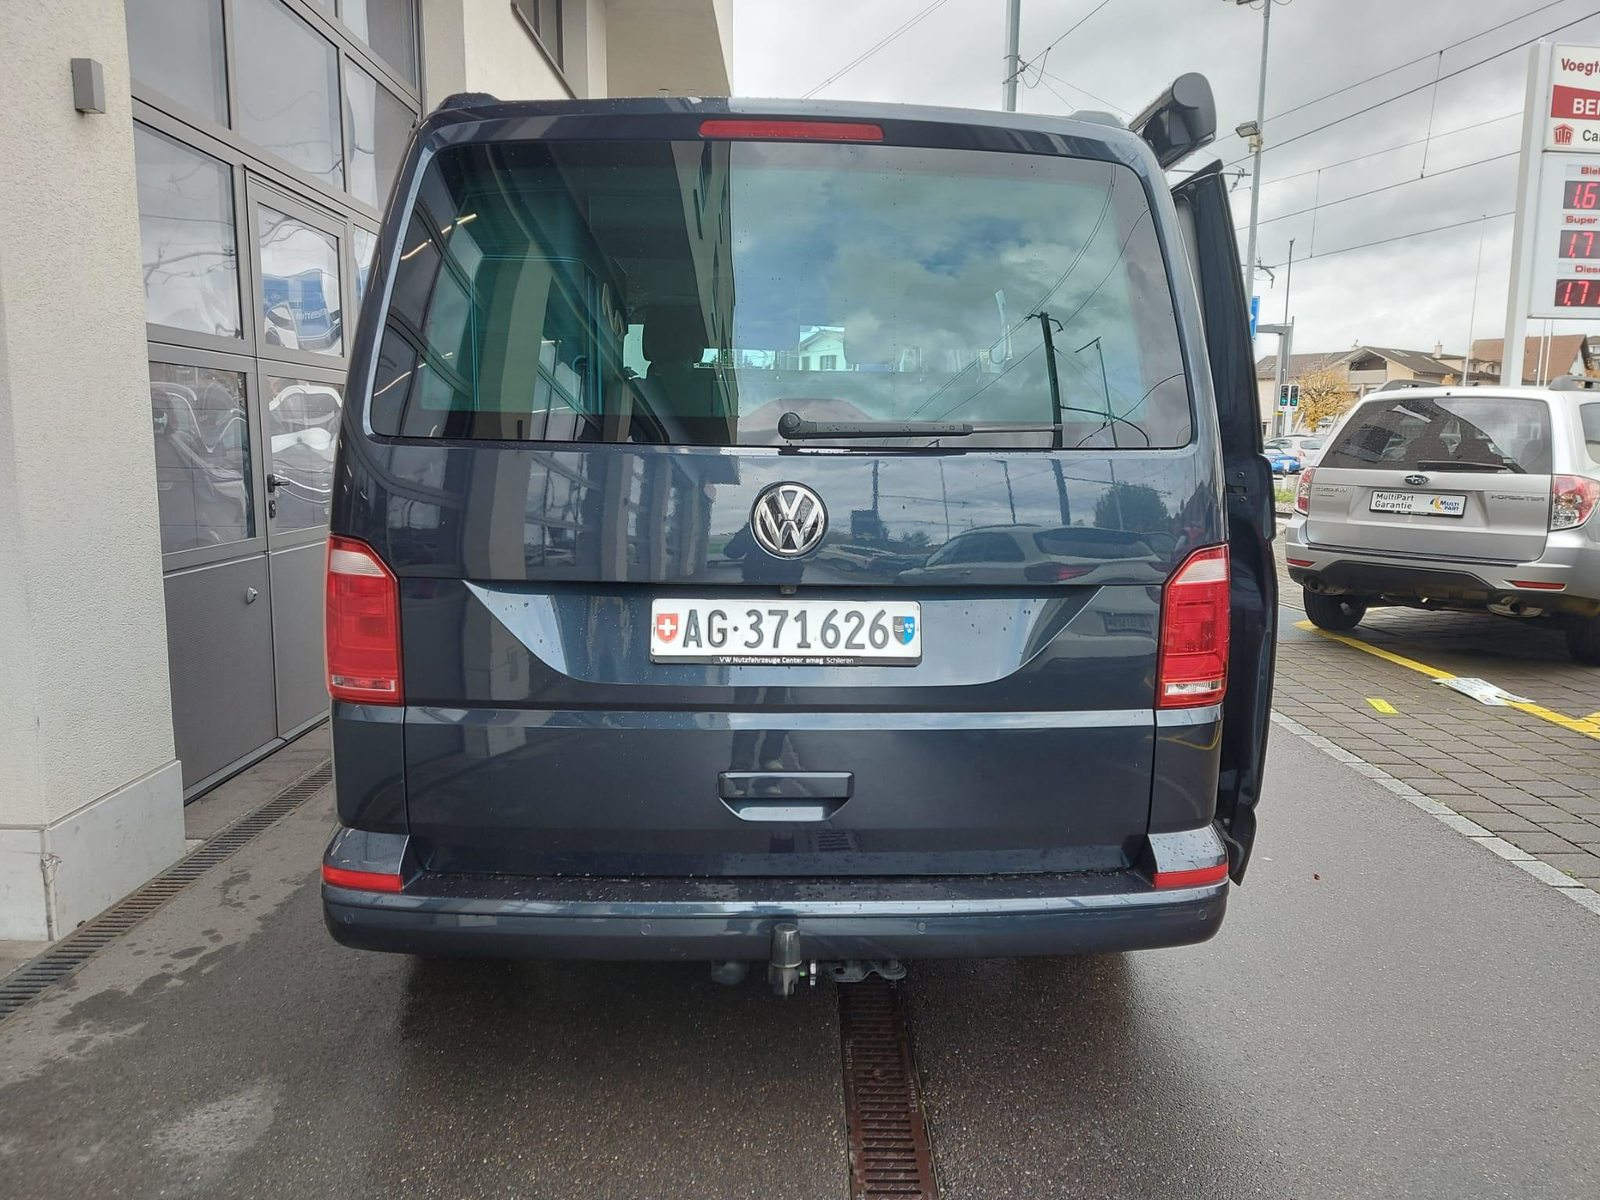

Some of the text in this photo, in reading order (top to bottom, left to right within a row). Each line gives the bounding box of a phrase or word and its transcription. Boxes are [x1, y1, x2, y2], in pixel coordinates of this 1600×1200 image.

[1582, 129, 1600, 142] Ca
[1566, 215, 1598, 225] Super
[1376, 493, 1414, 502] MultiPart
[1375, 500, 1413, 510] Garantie
[719, 656, 732, 664] VW
[733, 656, 780, 665] Nutzfahrzeuge
